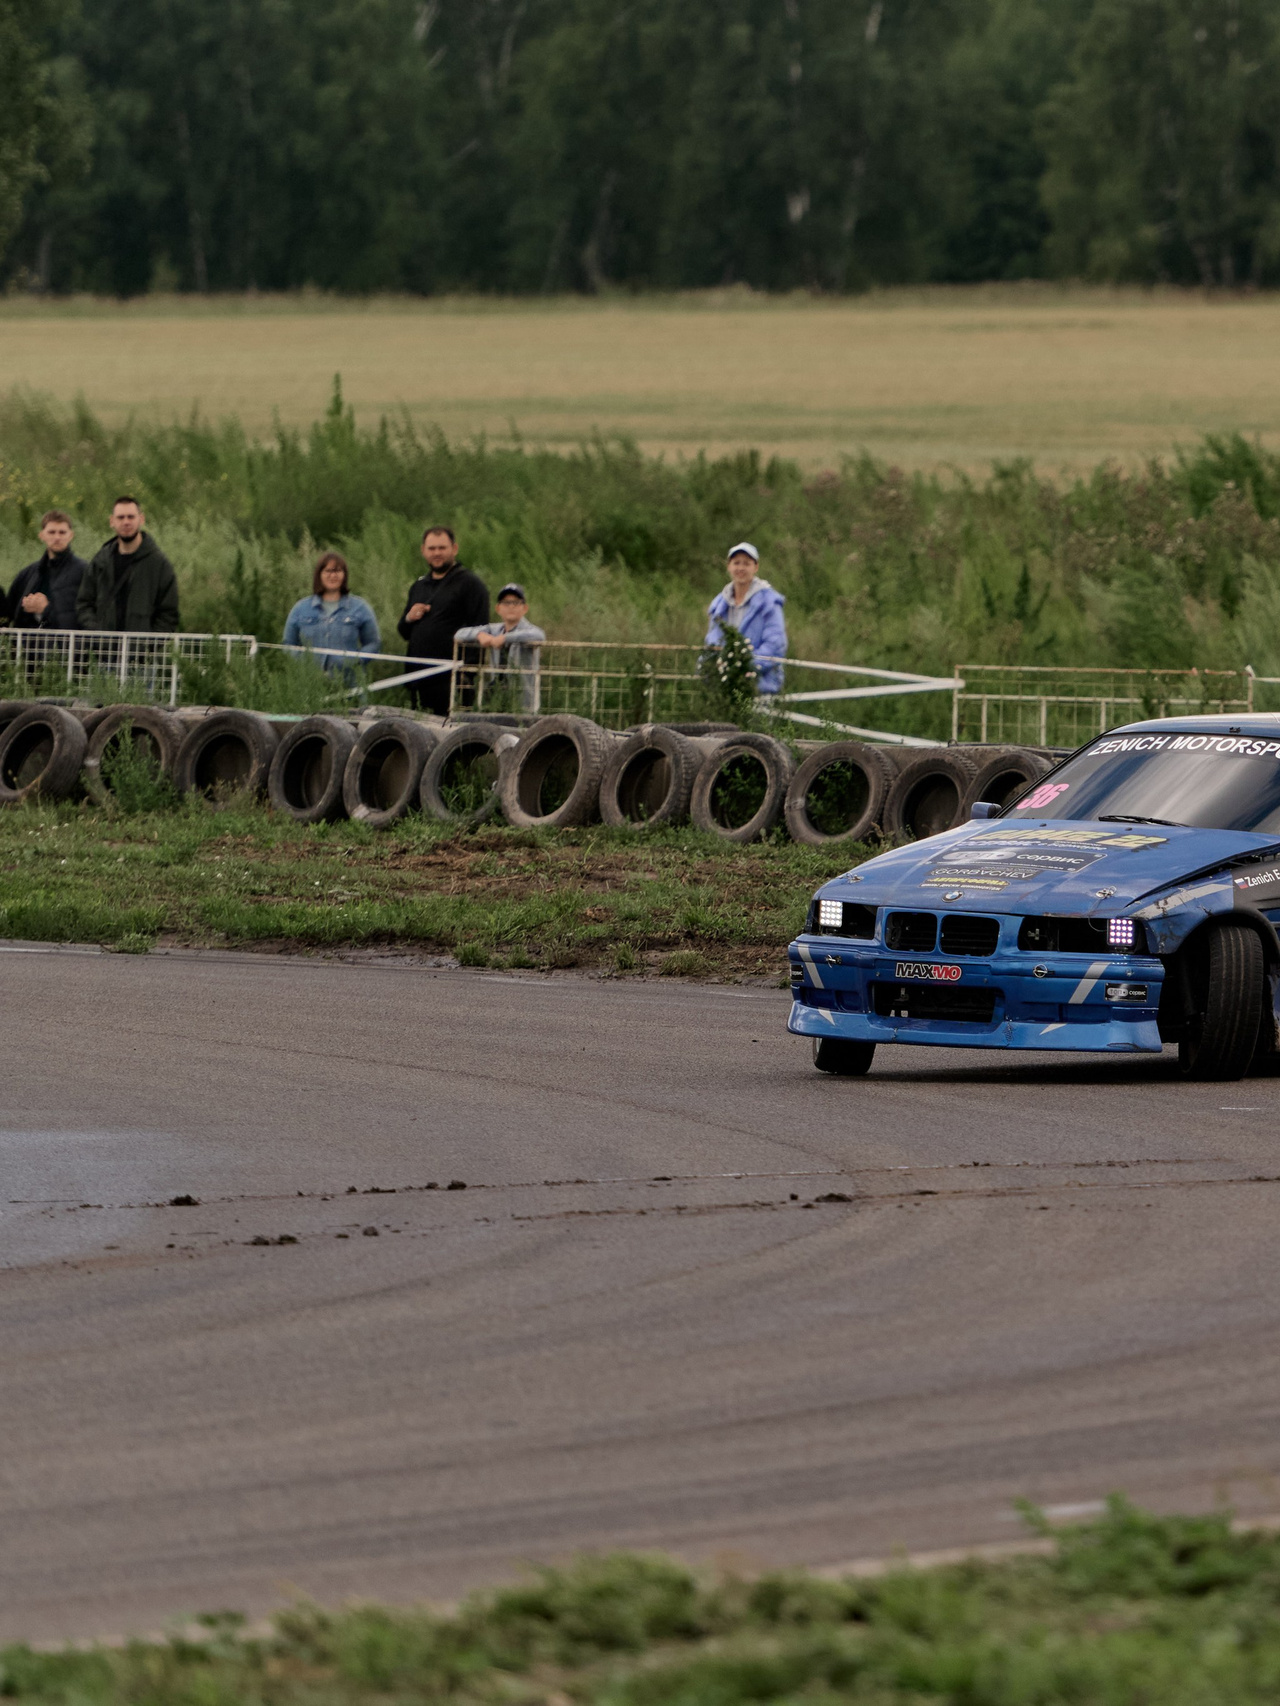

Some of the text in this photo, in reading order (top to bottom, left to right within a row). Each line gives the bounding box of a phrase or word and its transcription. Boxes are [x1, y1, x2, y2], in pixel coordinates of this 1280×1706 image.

[1088, 736, 1171, 756] ZENICH
[1016, 783, 1070, 810] 36
[1017, 854, 1085, 864] сервис
[1244, 871, 1275, 887] Zenich
[895, 962, 962, 980] MAXMO
